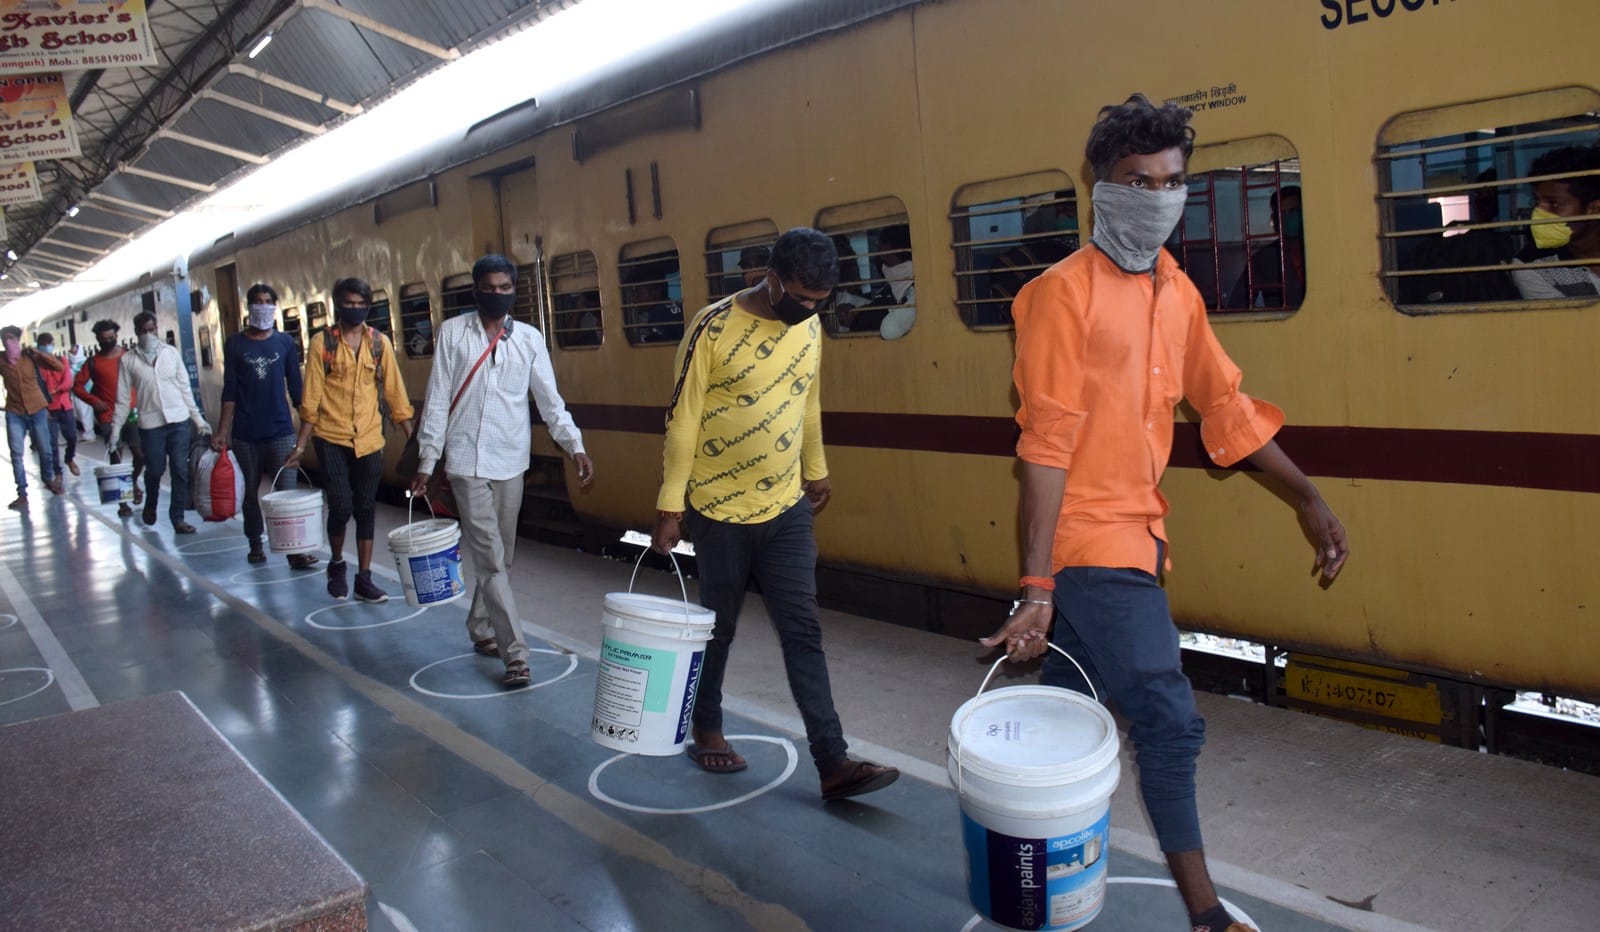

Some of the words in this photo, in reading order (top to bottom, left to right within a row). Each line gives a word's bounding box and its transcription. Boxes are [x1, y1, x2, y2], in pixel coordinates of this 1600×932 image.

[2, 6, 132, 31] Xavier's
[40, 28, 138, 50] School
[82, 53, 143, 65] 8858192001
[1208, 96, 1246, 109] WINDOW
[702, 400, 790, 457] Champion
